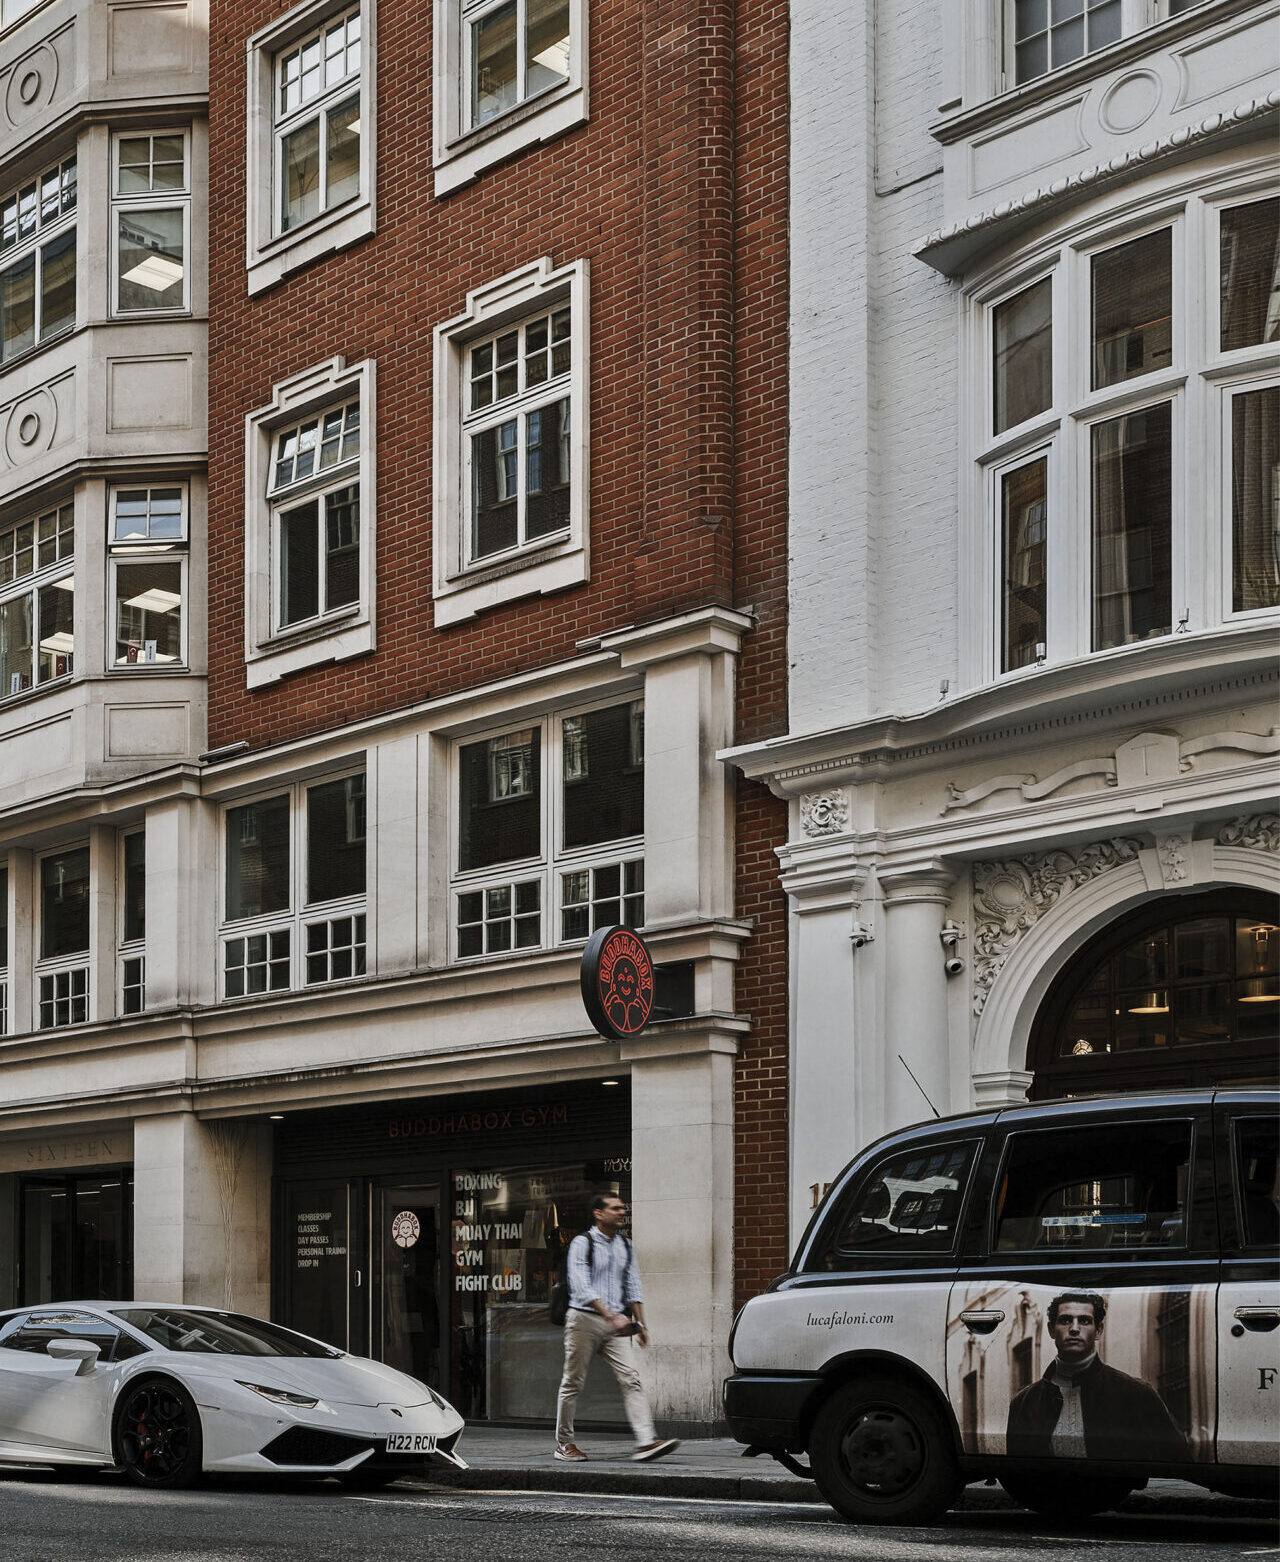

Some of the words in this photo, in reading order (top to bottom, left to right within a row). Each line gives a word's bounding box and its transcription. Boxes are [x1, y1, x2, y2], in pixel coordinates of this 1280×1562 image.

[600, 935, 651, 990] BUDDHABOX
[388, 1110, 513, 1138] BUDDHABOX
[521, 1104, 568, 1127] GYM
[24, 1138, 113, 1162] SIXTEEN
[455, 1173, 502, 1191] BOXING
[455, 1199, 474, 1216] BJJ
[297, 1212, 332, 1221] MEMBERSHIP
[393, 1212, 419, 1231] BUDDHABOX
[297, 1224, 319, 1233] CLASSES
[455, 1224, 491, 1241] MUAY
[494, 1223, 523, 1240] THAI
[297, 1236, 309, 1245] DAY
[310, 1235, 329, 1244] PASSES
[297, 1247, 324, 1256] PERSONAL
[325, 1246, 347, 1255] TRAININ
[455, 1249, 483, 1266] GYM
[297, 1259, 312, 1268] DROP
[313, 1259, 319, 1267] IN
[455, 1274, 489, 1292] FIGHT
[491, 1274, 522, 1292] CLUB
[806, 1310, 894, 1330] lucafaloni.com
[388, 1434, 412, 1450] H22
[414, 1435, 436, 1450] RCN
